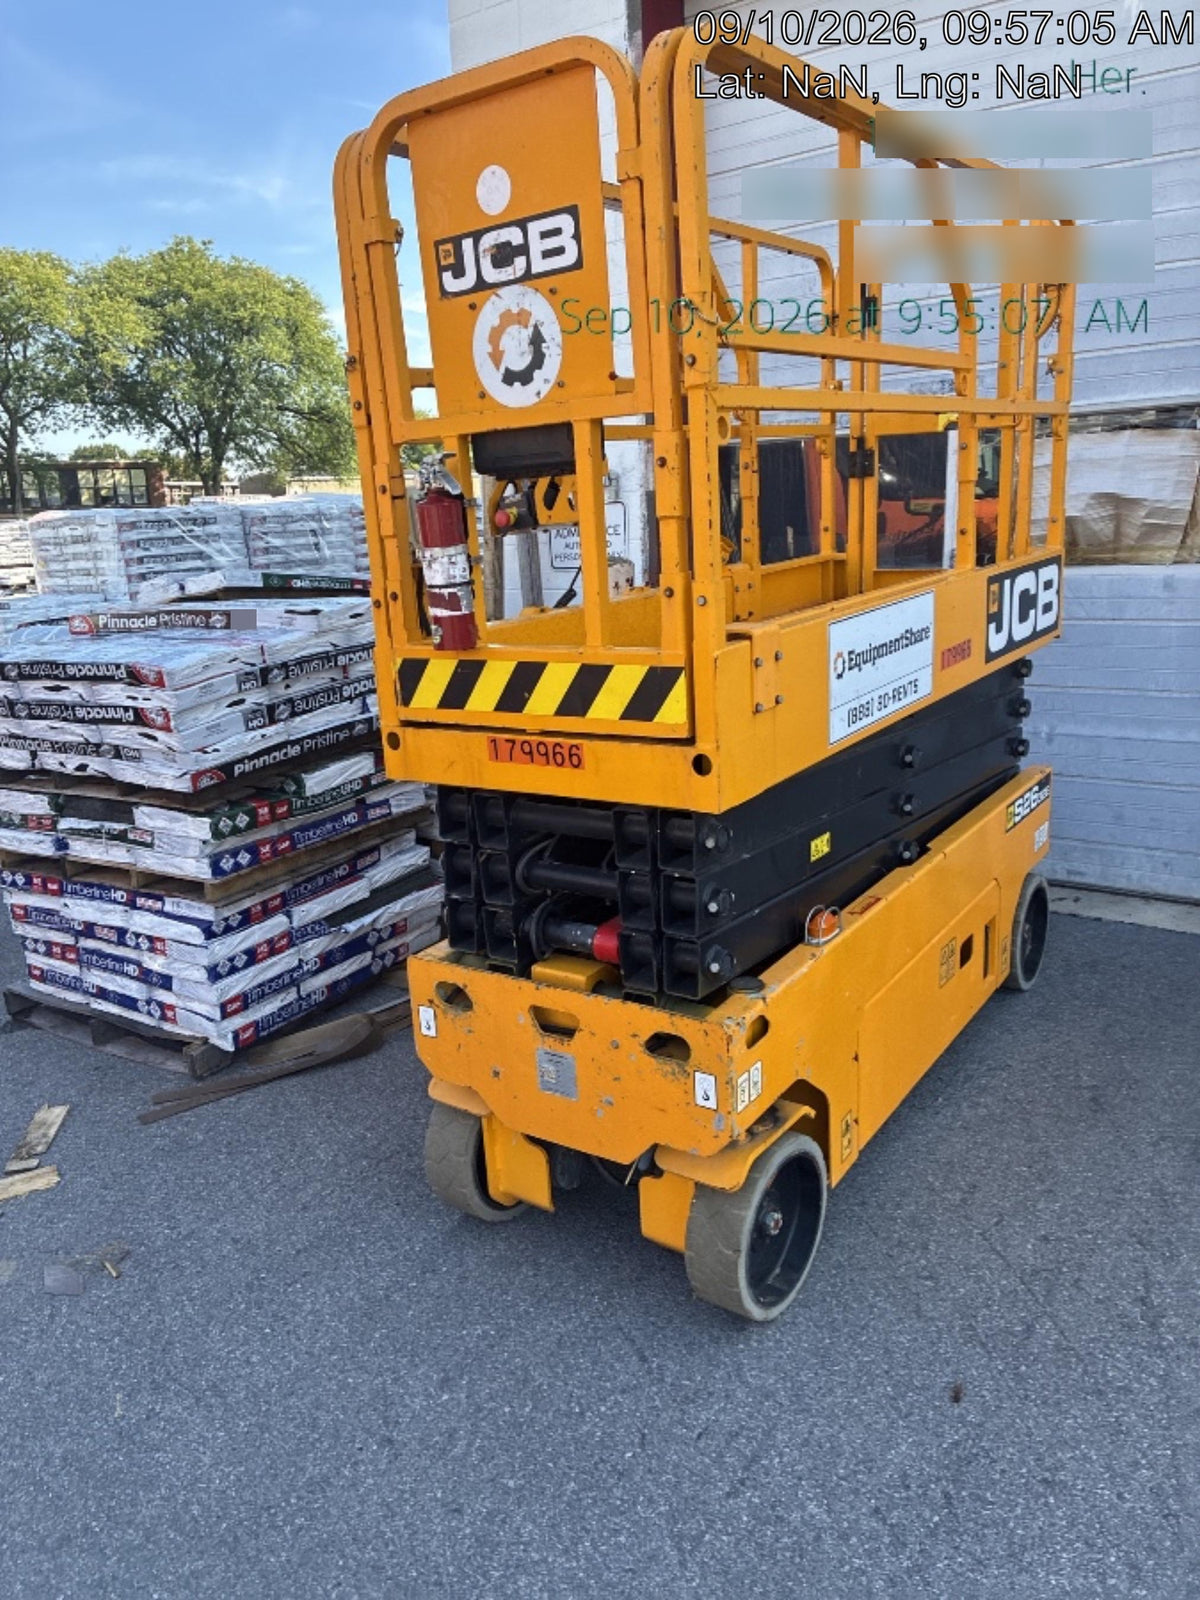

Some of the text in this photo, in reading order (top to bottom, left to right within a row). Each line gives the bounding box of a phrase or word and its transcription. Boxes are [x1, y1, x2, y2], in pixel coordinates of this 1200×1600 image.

[441, 211, 579, 294] JCB
[98, 611, 207, 629] Pinnacle Pristine
[988, 563, 1060, 654] JCB
[847, 625, 931, 673] EquipmentShare
[66, 665, 128, 680] Pinnacle
[75, 706, 135, 722] Pinnacle
[294, 686, 341, 713] Pristine
[233, 728, 350, 778] Pinnacle Pristine
[490, 738, 583, 769] 179966
